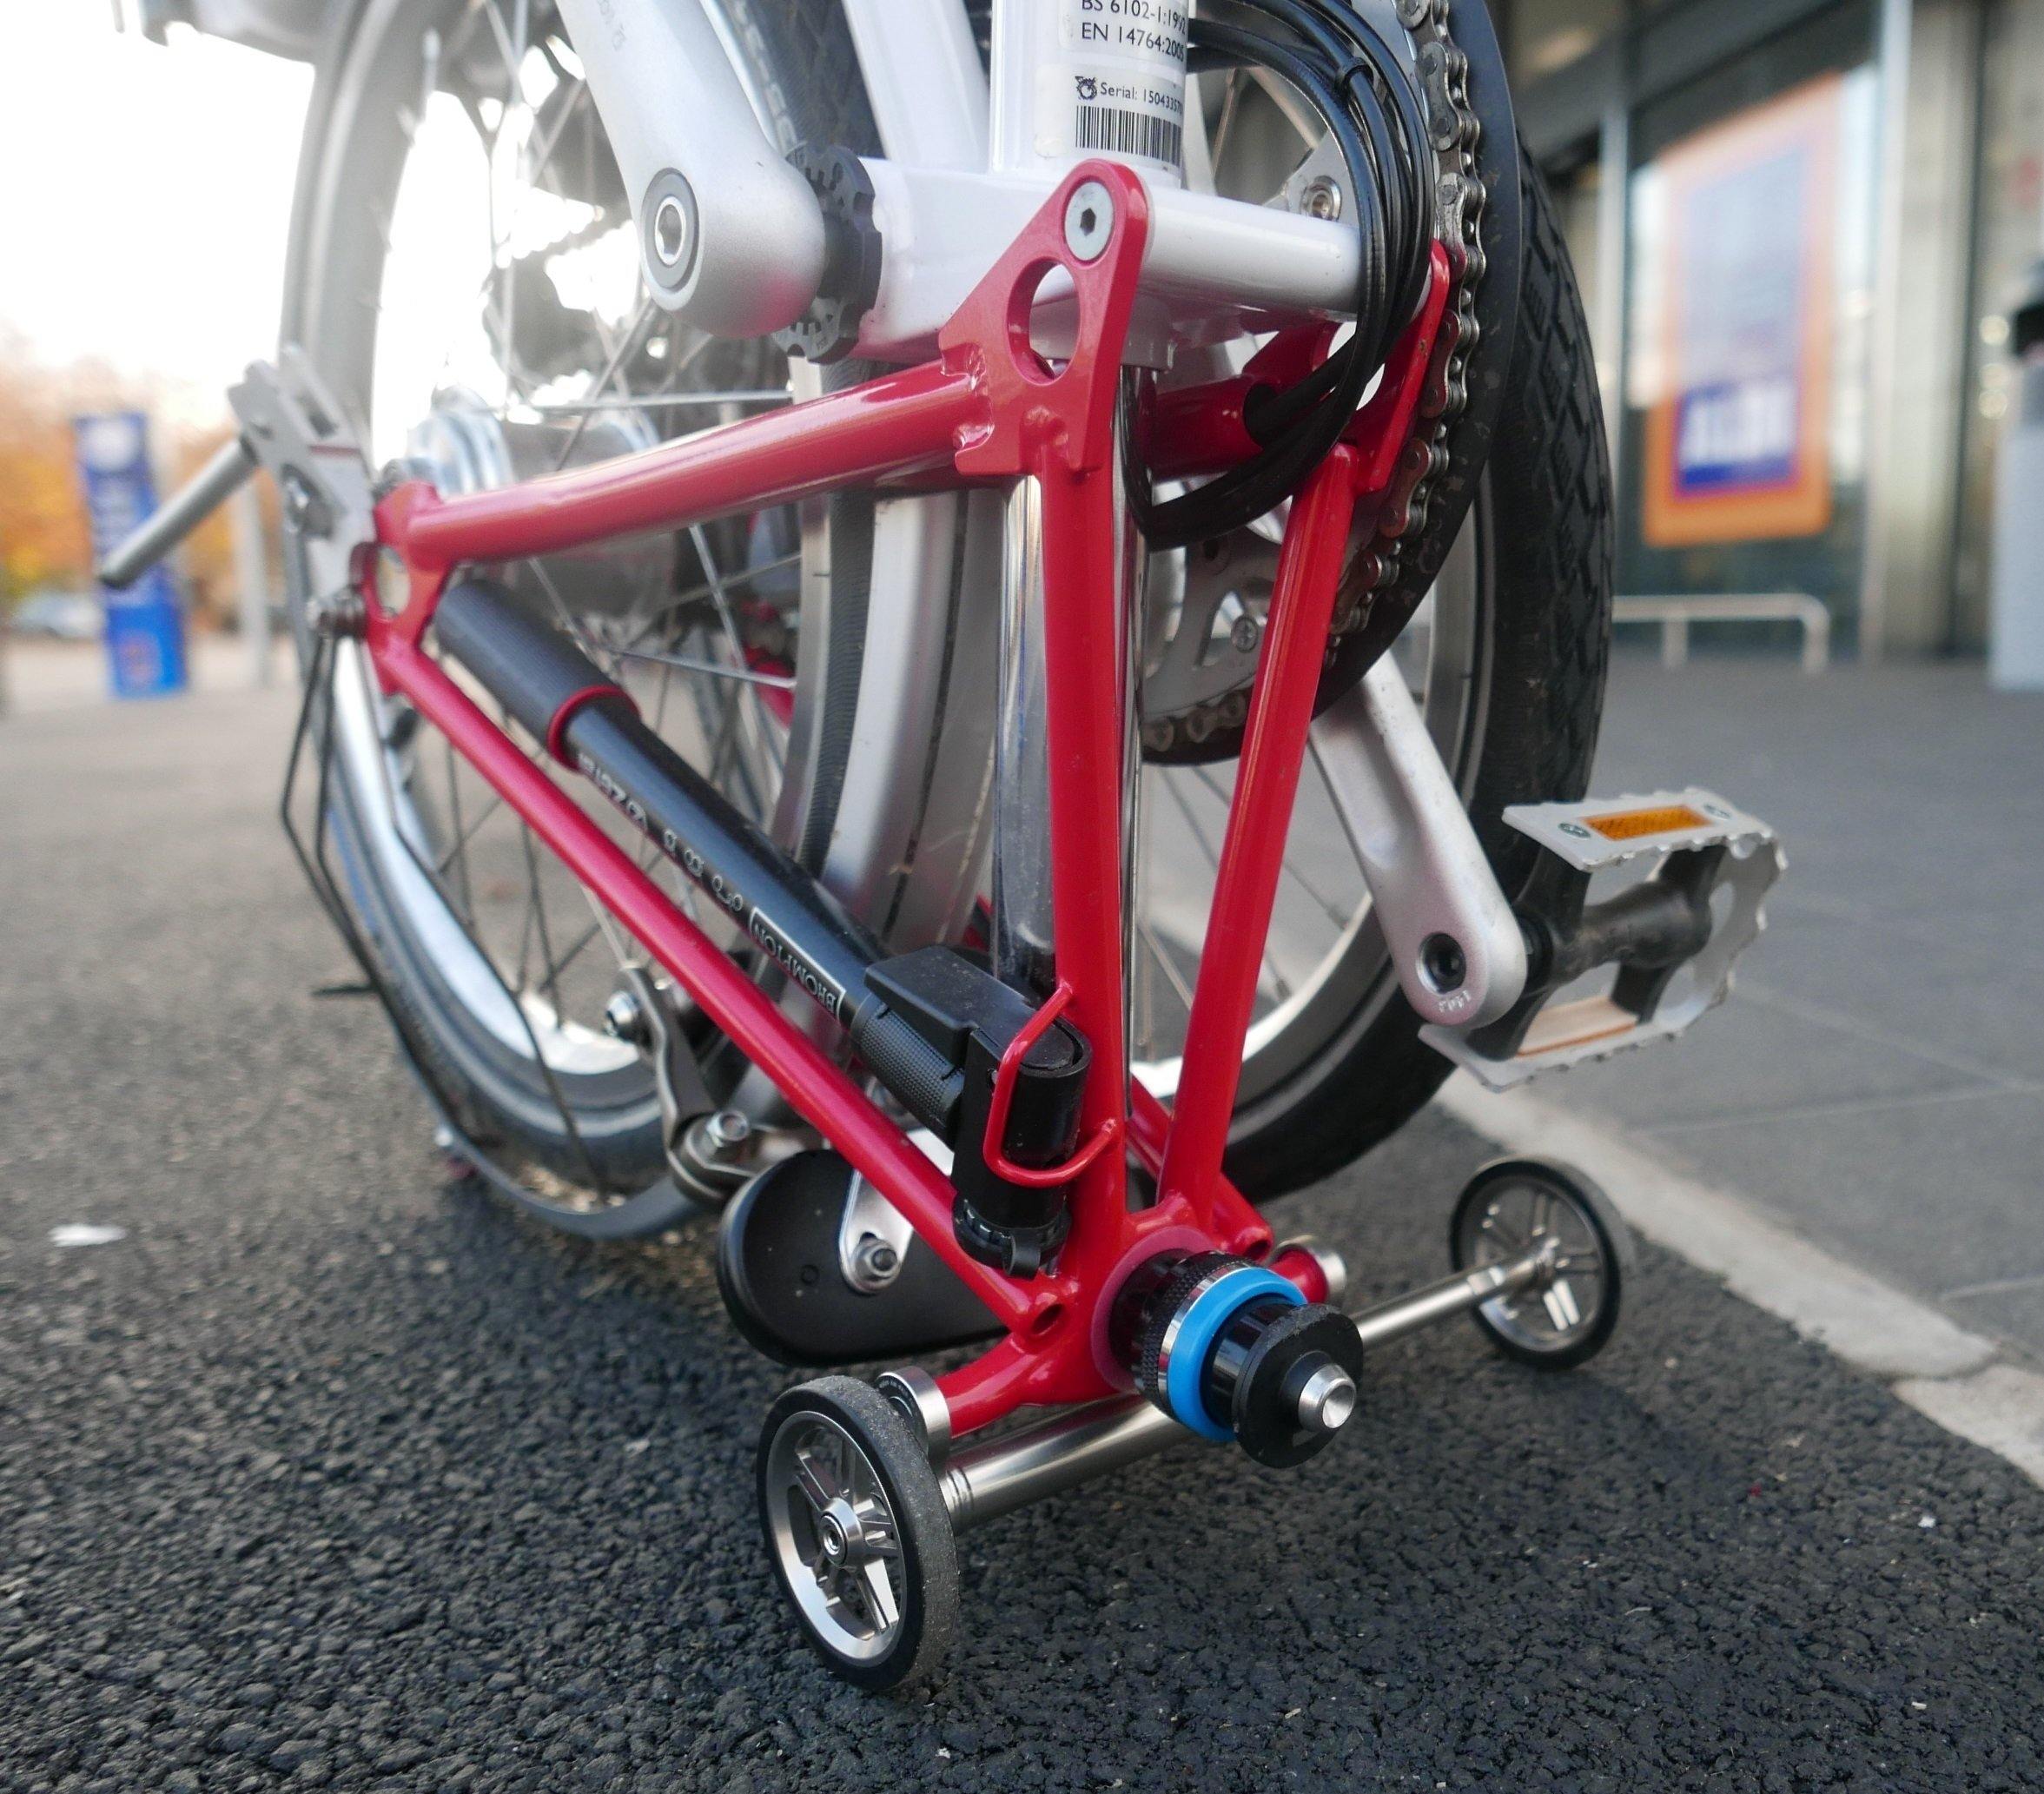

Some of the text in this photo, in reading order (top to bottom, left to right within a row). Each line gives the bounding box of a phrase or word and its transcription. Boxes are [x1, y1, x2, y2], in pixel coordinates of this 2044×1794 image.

[1082, 0, 1186, 35] BS 6102-1:1992
[1082, 22, 1185, 62] EN 14764:2005
[1100, 82, 1138, 101] Serial:
